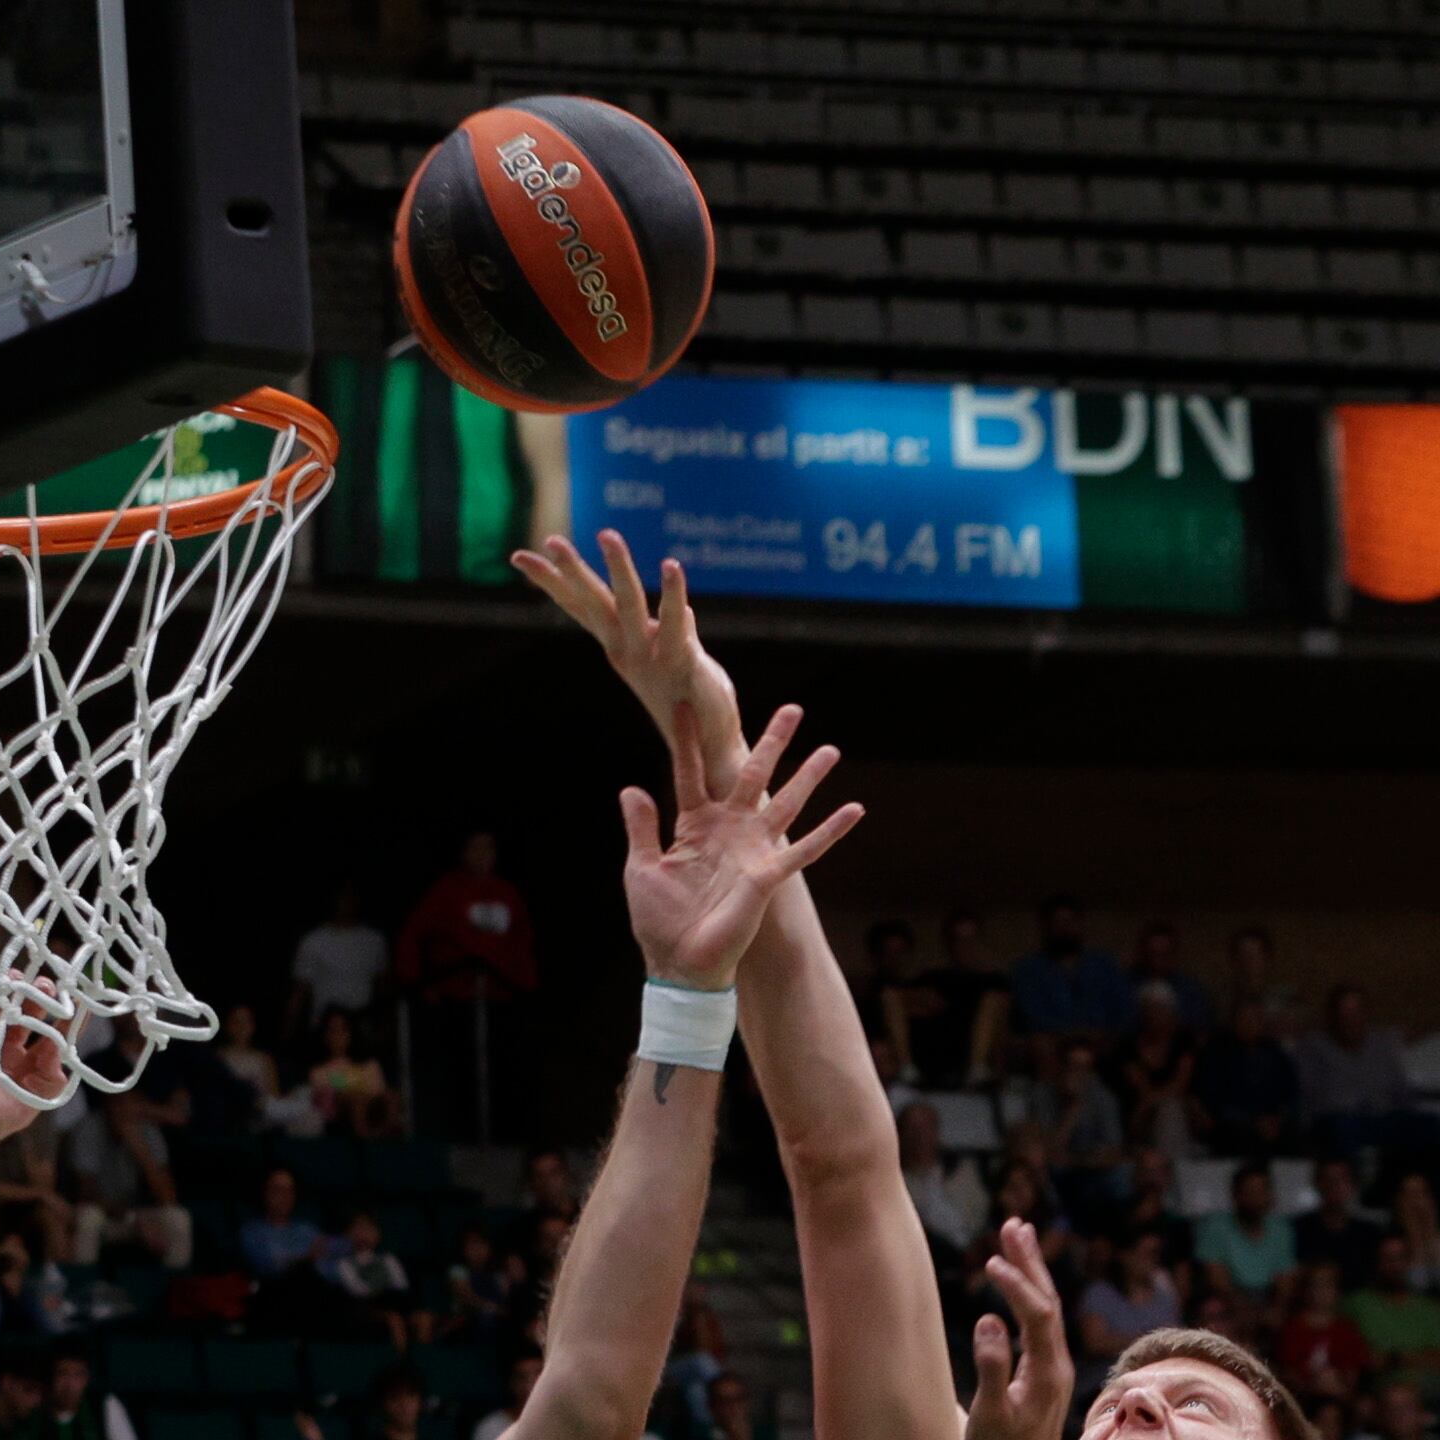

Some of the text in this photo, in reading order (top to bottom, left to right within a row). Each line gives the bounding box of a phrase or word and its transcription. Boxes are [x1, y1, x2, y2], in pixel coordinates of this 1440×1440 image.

[948, 386, 1254, 482] BDN
[821, 518, 1043, 579] 94.4 FM
